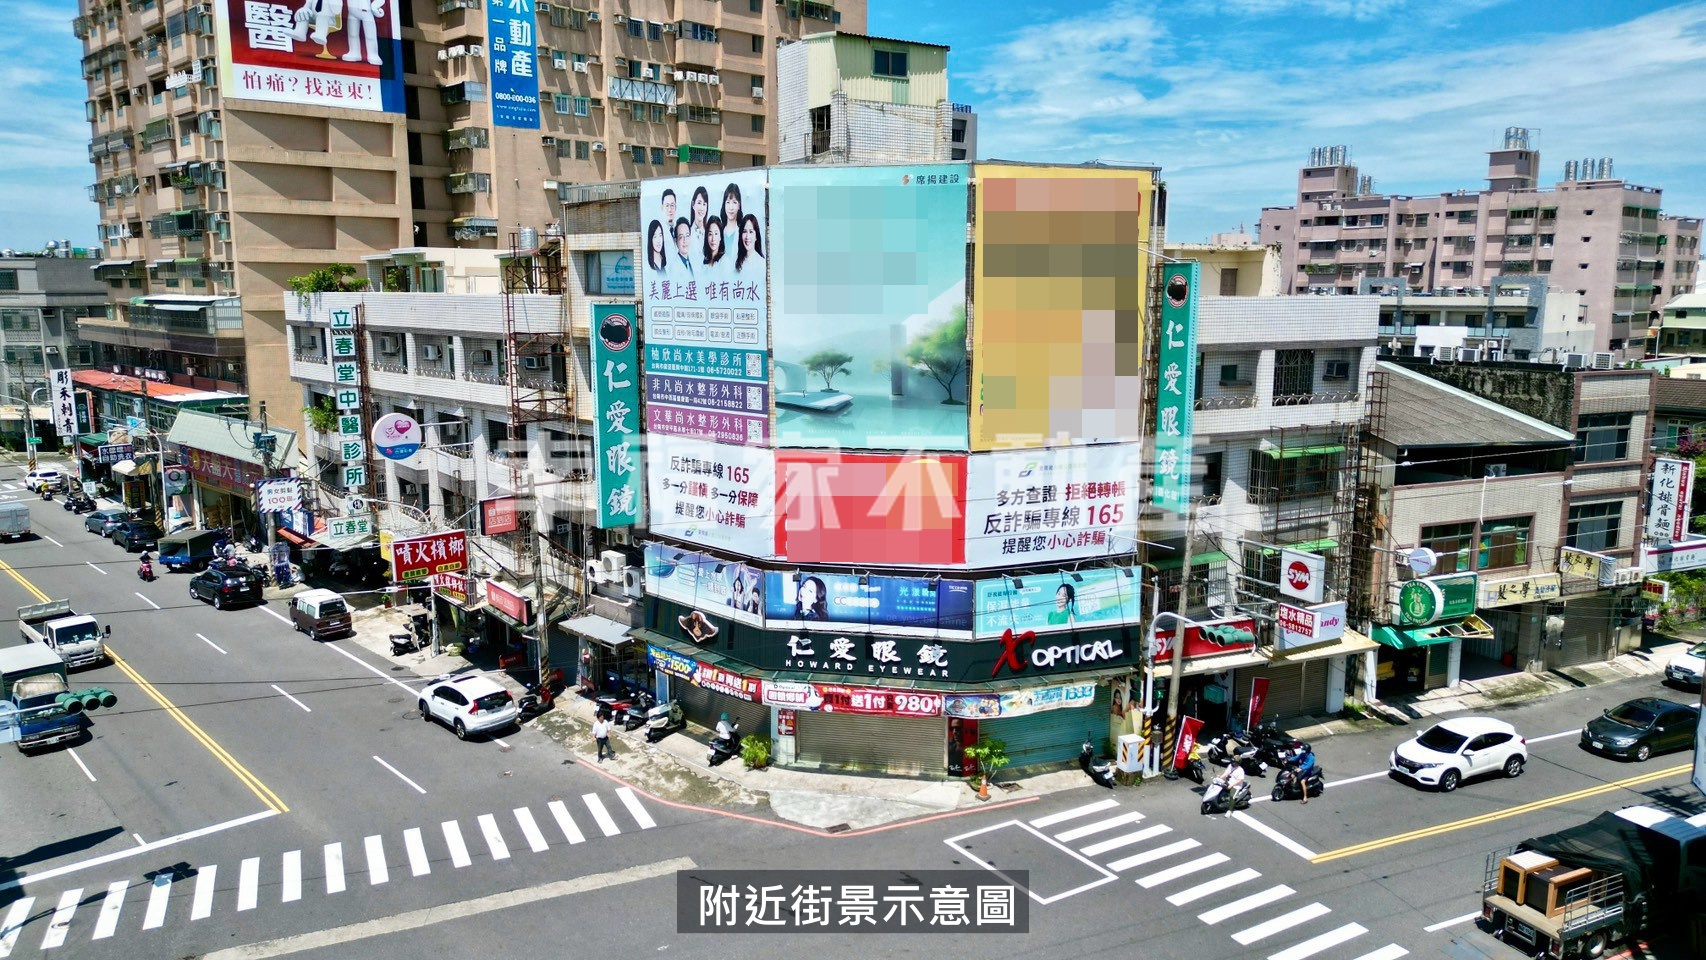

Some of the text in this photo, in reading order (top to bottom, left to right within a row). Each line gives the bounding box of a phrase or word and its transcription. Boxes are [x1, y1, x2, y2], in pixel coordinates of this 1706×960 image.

[649, 280, 698, 301] 美麗上選
[705, 280, 760, 301] 唯有尚水
[706, 366, 742, 376] 06-5720022
[332, 310, 363, 486] 立春堂中醫診所
[653, 378, 743, 399] 非凡尚水整形外科
[1158, 319, 1185, 481] 仁愛眼鏡
[603, 359, 637, 517] 仁愛眼鏡
[670, 455, 750, 484] 反詐騙專線 165
[662, 478, 759, 508] 多一分謹慎 多一分保障
[996, 480, 1126, 507] 多方查證 拒絕轉帳
[1654, 462, 1677, 532] 新化排骨麵
[333, 520, 368, 536] 立春堂
[675, 500, 746, 529] 提醒您小心詐騙
[983, 503, 1125, 535] 反詐騙專線 165
[396, 537, 465, 566] 噴火檳榔
[1002, 530, 1106, 555] 提醒您小心詐騙
[1288, 568, 1311, 584] SYM
[787, 635, 949, 667] 仁愛眼鏡
[1032, 639, 1123, 667] OPTICAL
[786, 659, 949, 678] HOWARD EYEWEAR
